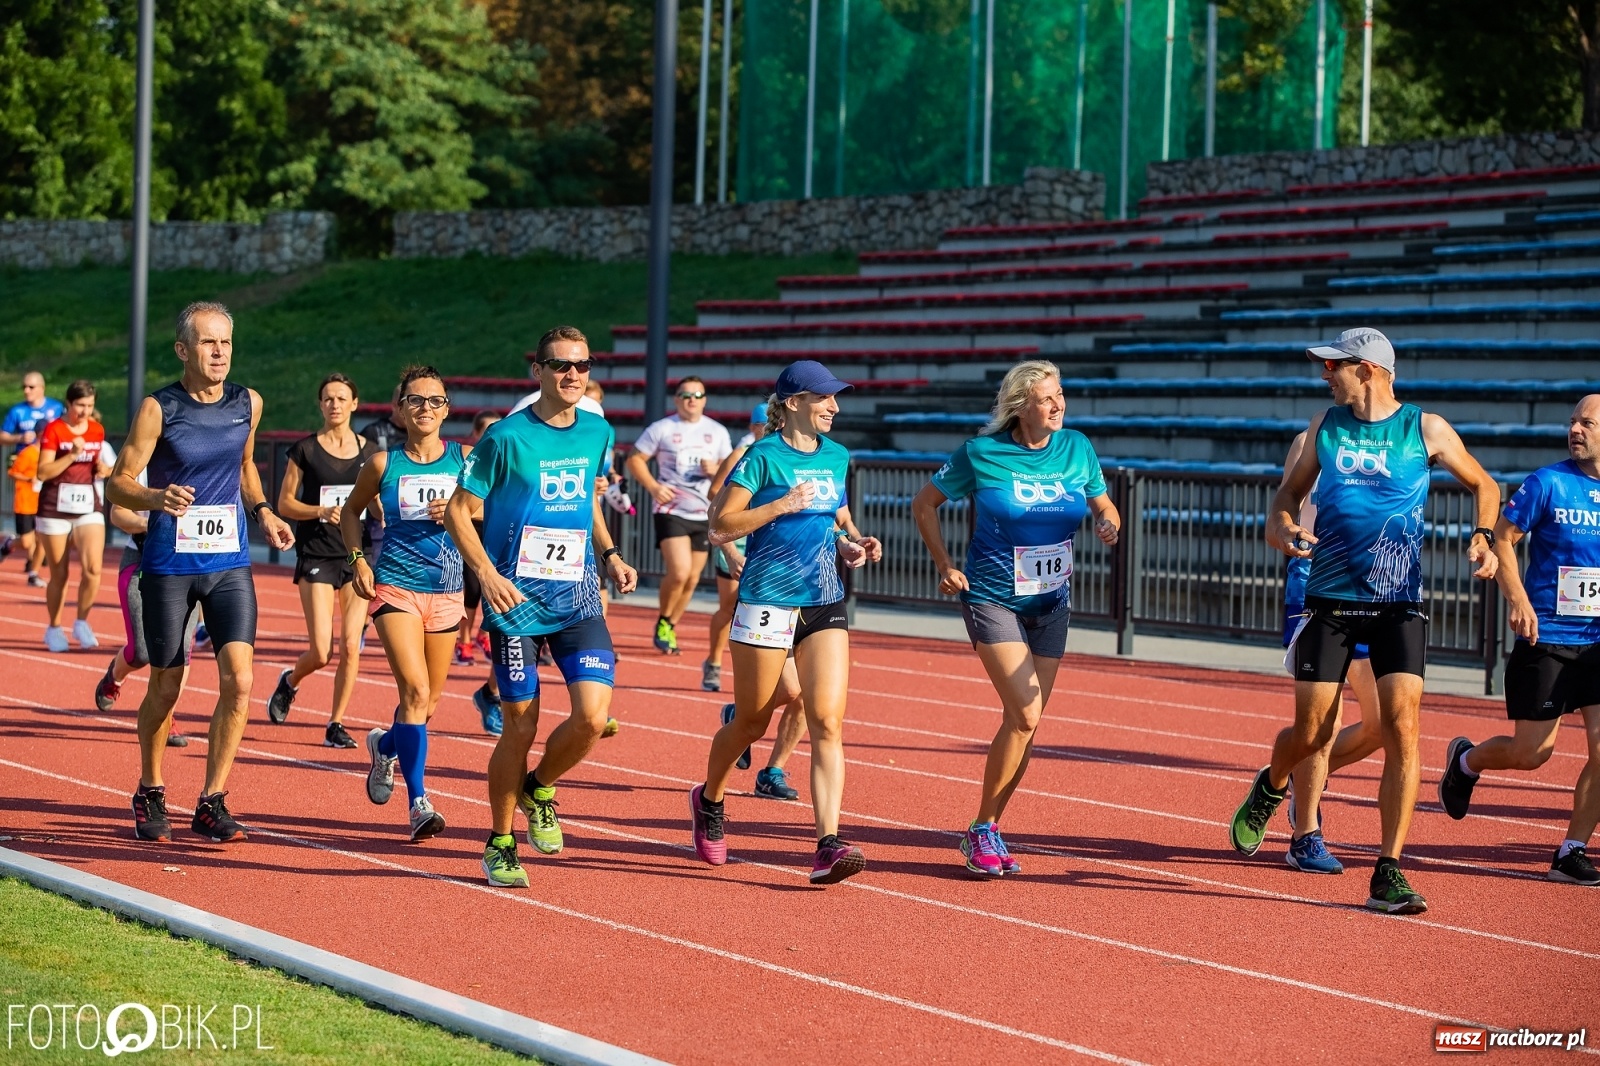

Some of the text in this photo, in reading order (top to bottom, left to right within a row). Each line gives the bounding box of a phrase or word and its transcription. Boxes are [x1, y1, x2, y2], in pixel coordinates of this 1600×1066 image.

[1336, 446, 1391, 478] bbl
[540, 469, 587, 501] bbl
[1013, 480, 1075, 503] bbl
[1344, 479, 1380, 487] RACIBÓRZ
[417, 488, 446, 503] 101
[544, 503, 578, 512] RACIBÓRZ
[1554, 508, 1600, 527] RUN
[197, 519, 224, 536] 106
[545, 543, 567, 561] 72
[1035, 557, 1062, 576] 118
[1578, 581, 1600, 598] 15
[759, 610, 771, 627] 3
